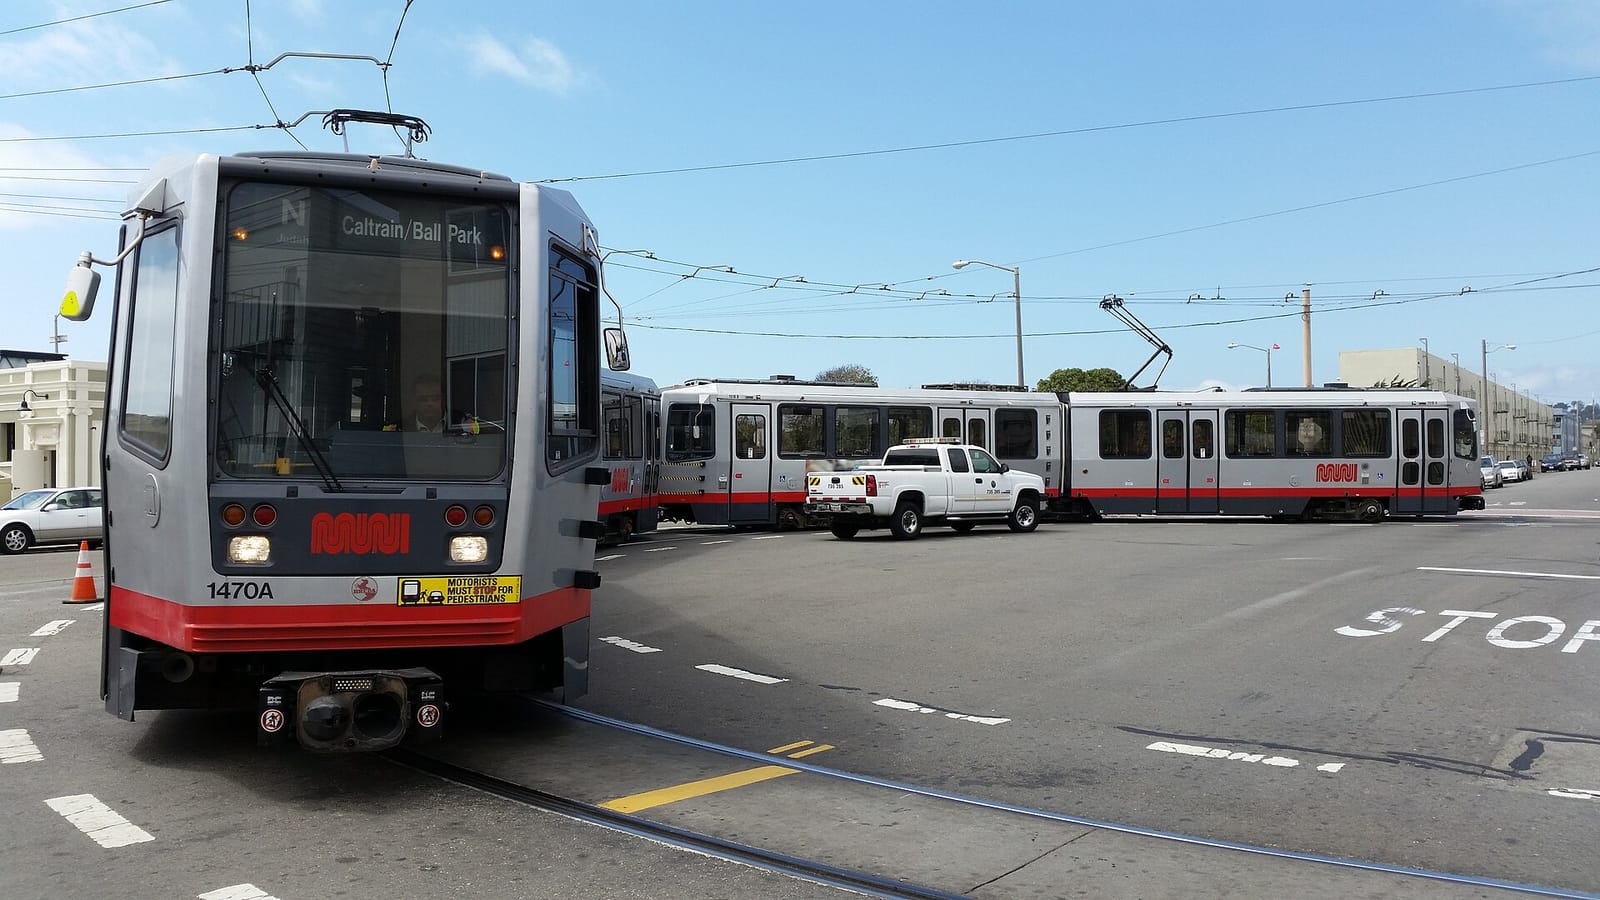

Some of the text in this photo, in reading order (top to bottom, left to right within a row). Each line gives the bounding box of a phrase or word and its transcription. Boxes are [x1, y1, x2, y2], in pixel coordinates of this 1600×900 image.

[281, 199, 305, 226] N
[342, 214, 482, 245] Caltrain/Ball Park
[447, 578, 498, 587] MOTORISTS
[207, 582, 274, 600] 1470A
[447, 586, 513, 595] MUST STOP FOR
[447, 595, 506, 604] PEDESTRIANS
